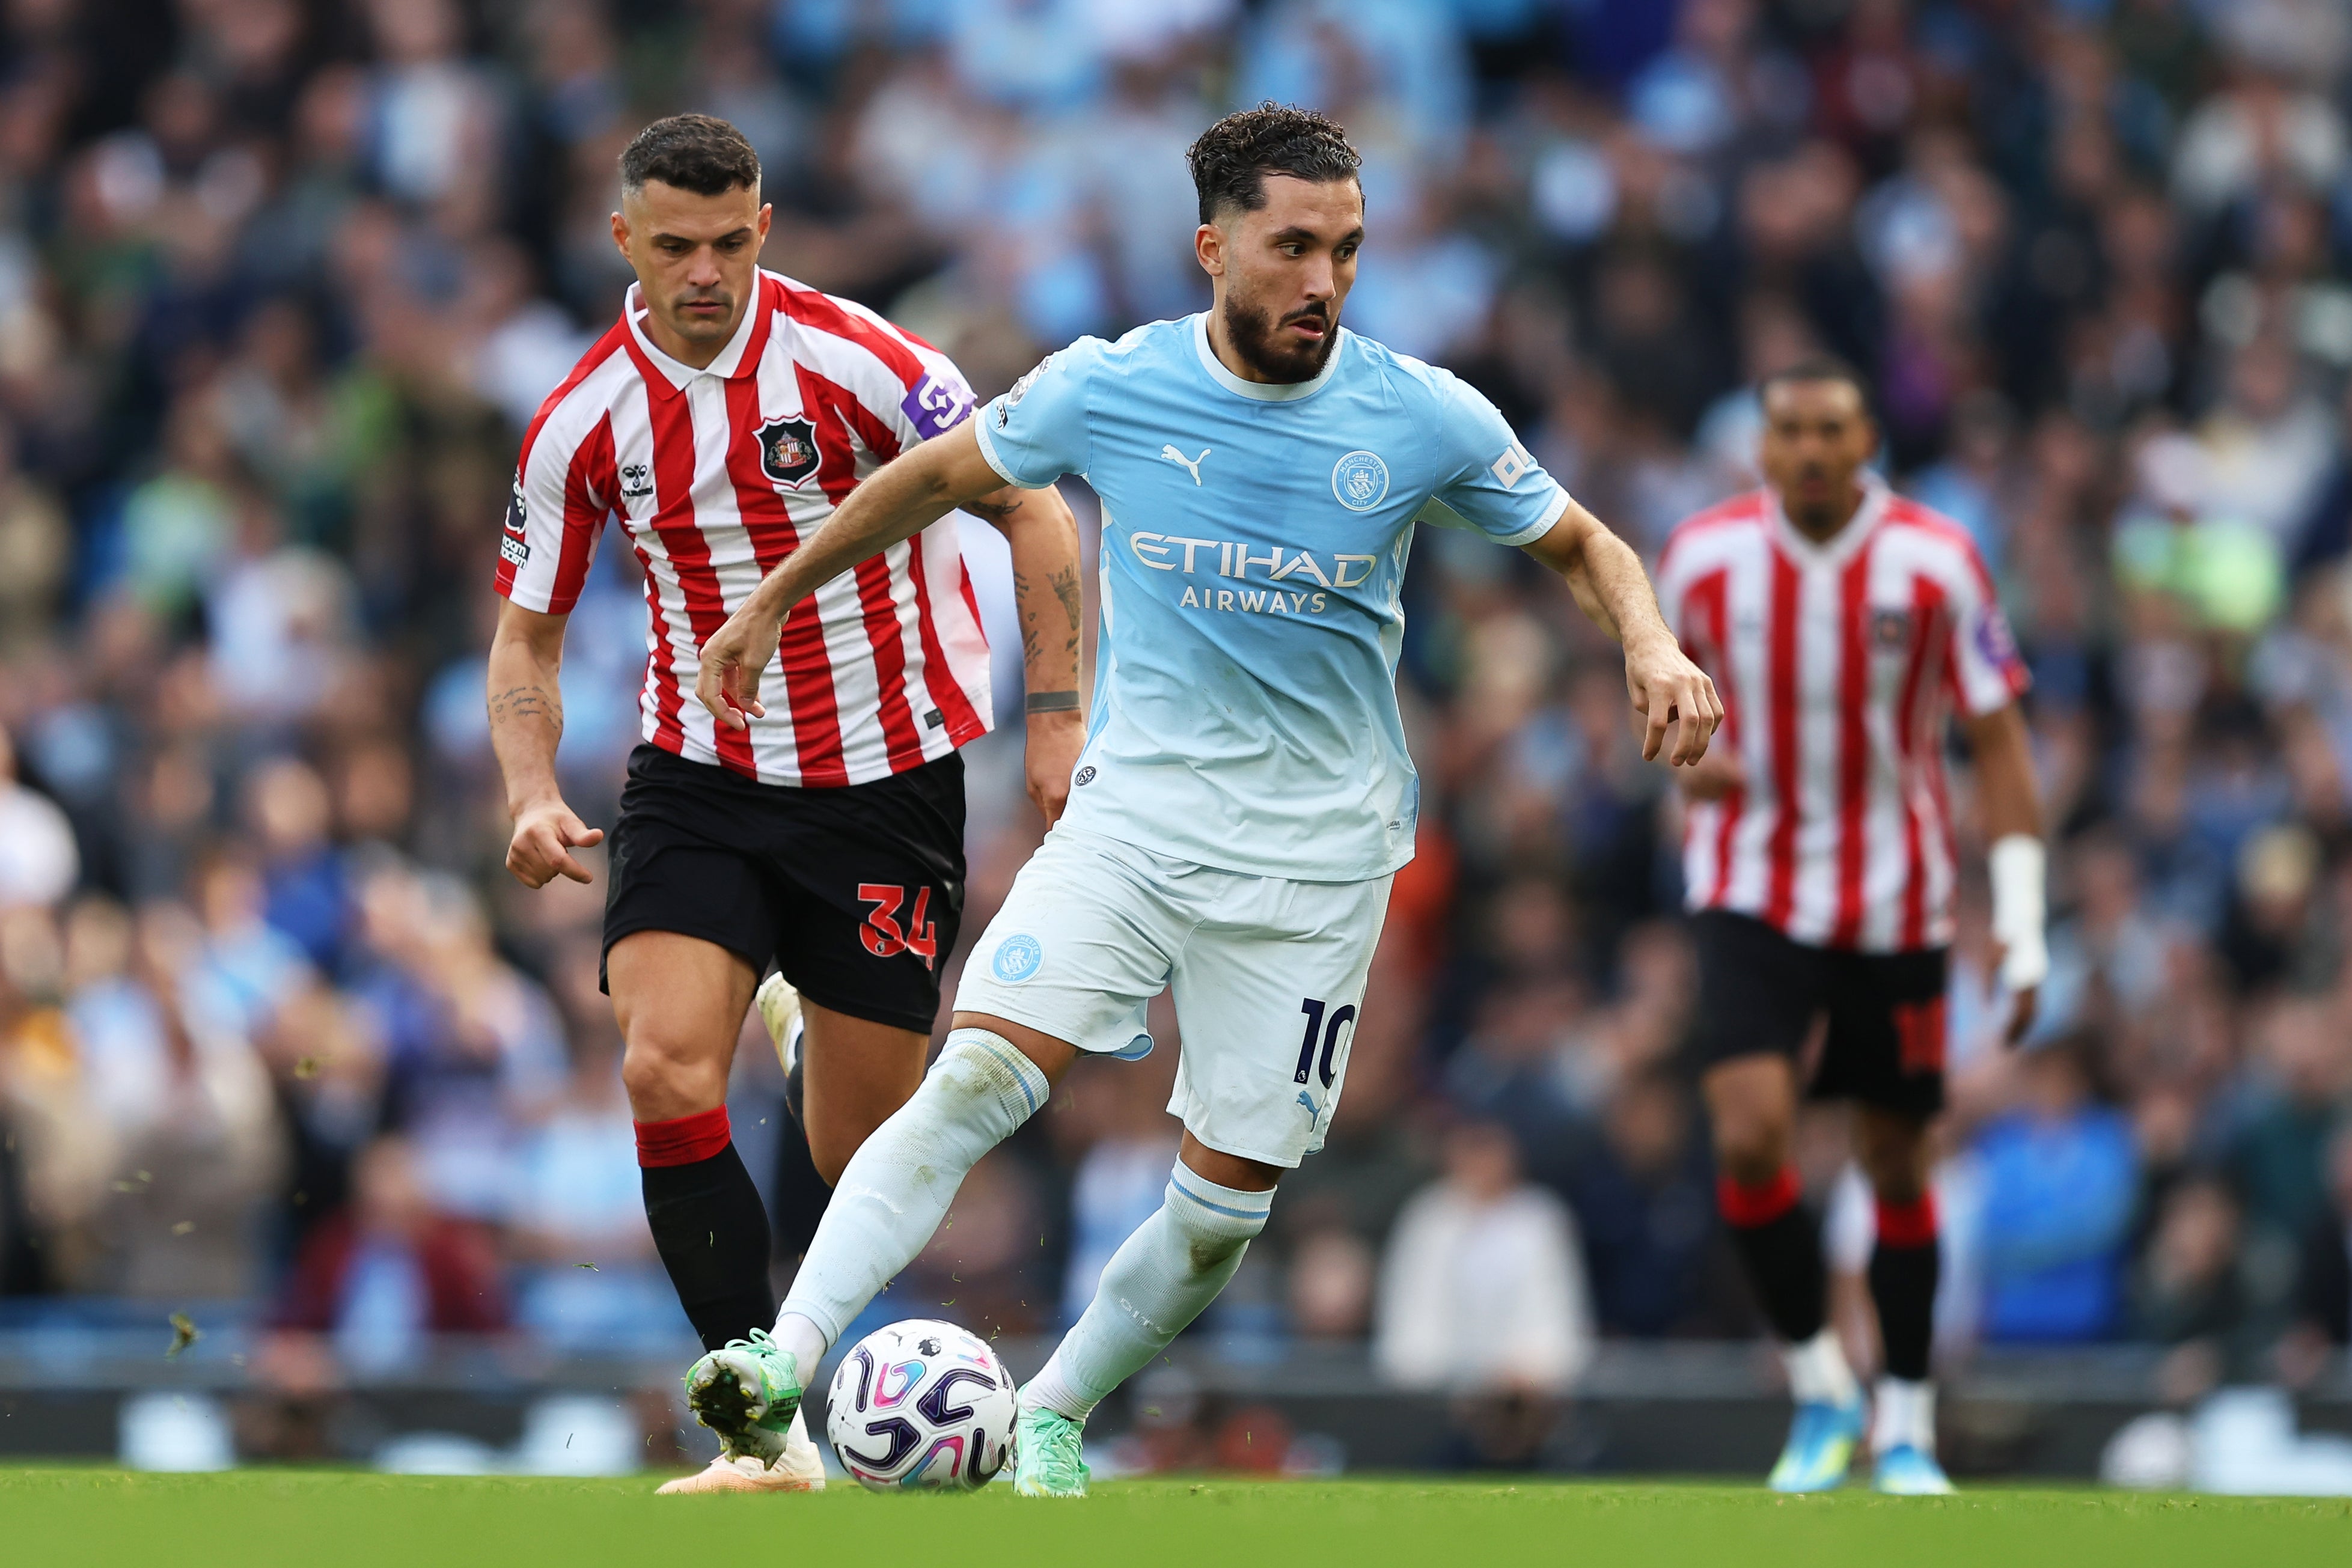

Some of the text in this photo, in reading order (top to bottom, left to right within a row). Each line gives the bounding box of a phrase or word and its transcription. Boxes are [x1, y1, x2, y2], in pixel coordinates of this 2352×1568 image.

[1340, 457, 1382, 475] MANCHESTER
[622, 485, 653, 498] hummel
[1130, 531, 1376, 588] ETIHAD
[1179, 585, 1326, 613] AIRWAYS
[858, 883, 936, 971] 34
[1000, 936, 1040, 955] MANCHESTER
[1294, 997, 1355, 1089] 10
